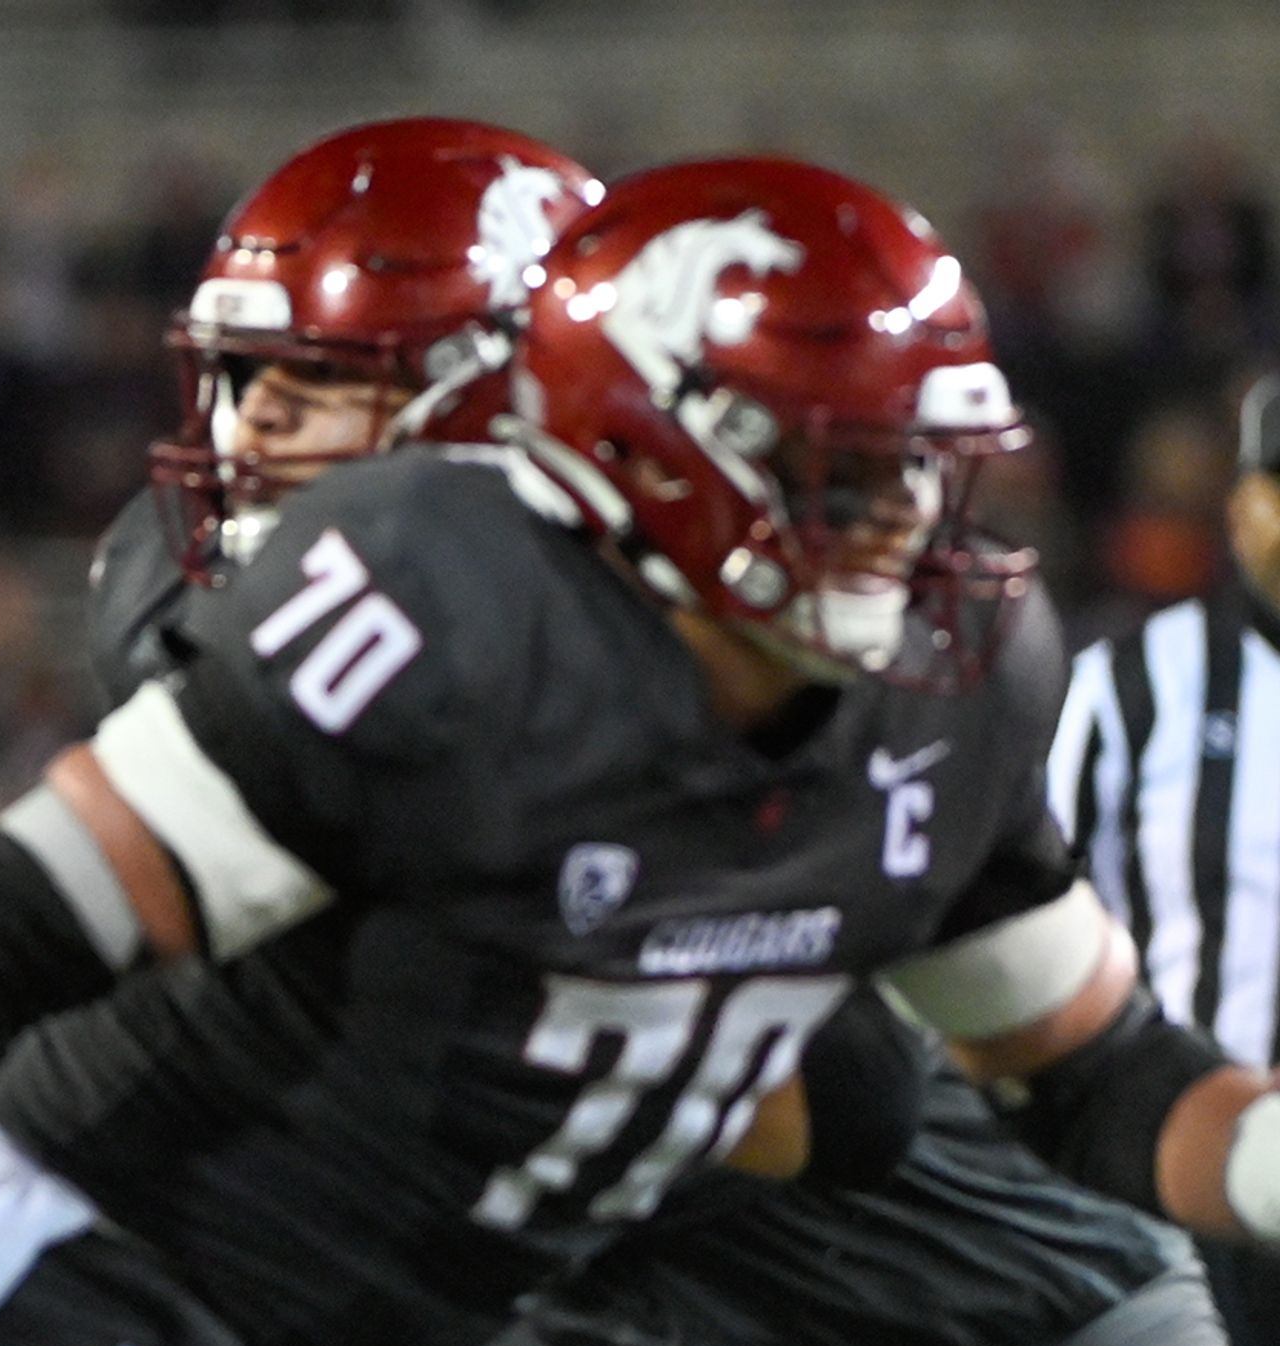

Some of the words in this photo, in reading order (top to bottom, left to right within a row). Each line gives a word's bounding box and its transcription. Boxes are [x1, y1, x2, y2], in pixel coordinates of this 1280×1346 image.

[249, 529, 424, 735] 70
[880, 782, 934, 877] C
[471, 973, 851, 1230] 70
